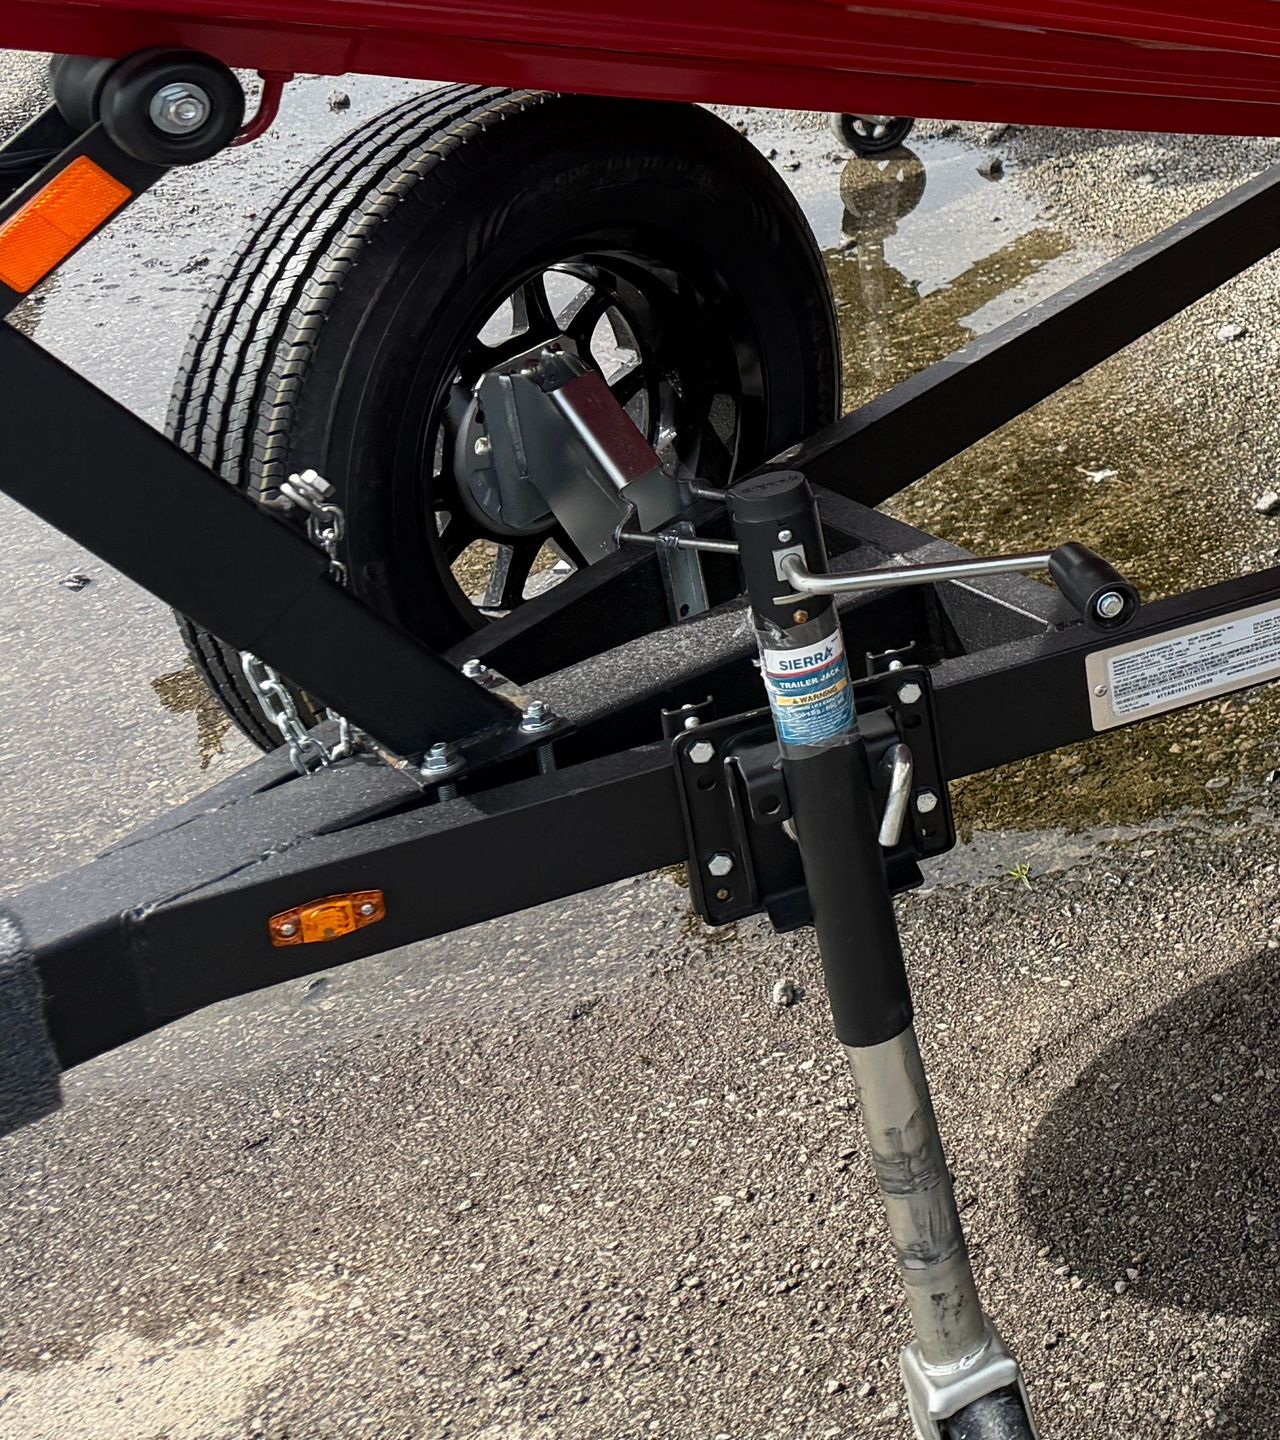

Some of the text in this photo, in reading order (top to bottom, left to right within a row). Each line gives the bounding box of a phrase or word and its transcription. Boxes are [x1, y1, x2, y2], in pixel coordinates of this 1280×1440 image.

[779, 645, 834, 671] SIERRA
[779, 667, 841, 690] TRAILER JACK
